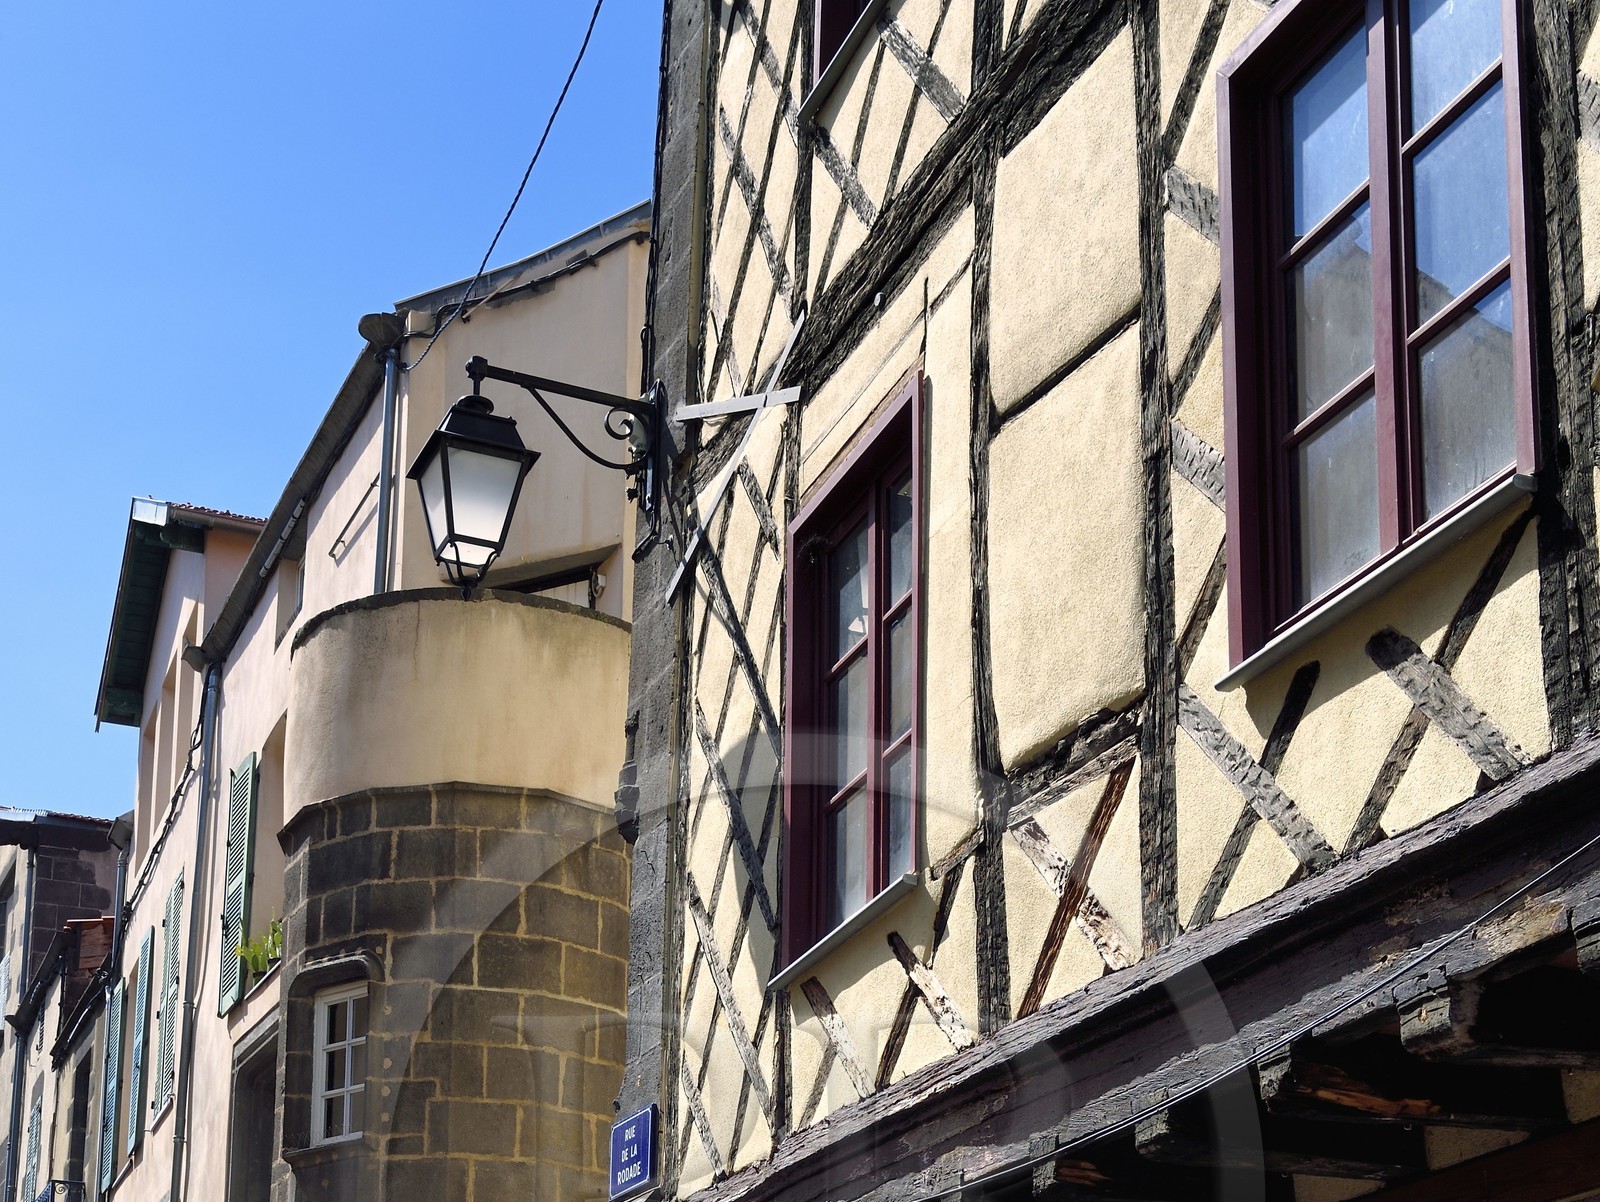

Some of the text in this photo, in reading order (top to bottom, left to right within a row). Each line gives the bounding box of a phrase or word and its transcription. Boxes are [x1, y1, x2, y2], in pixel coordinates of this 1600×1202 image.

[625, 1125, 635, 1141] RUE
[621, 1143, 637, 1162] DE LA
[617, 1161, 641, 1185] RODADE
